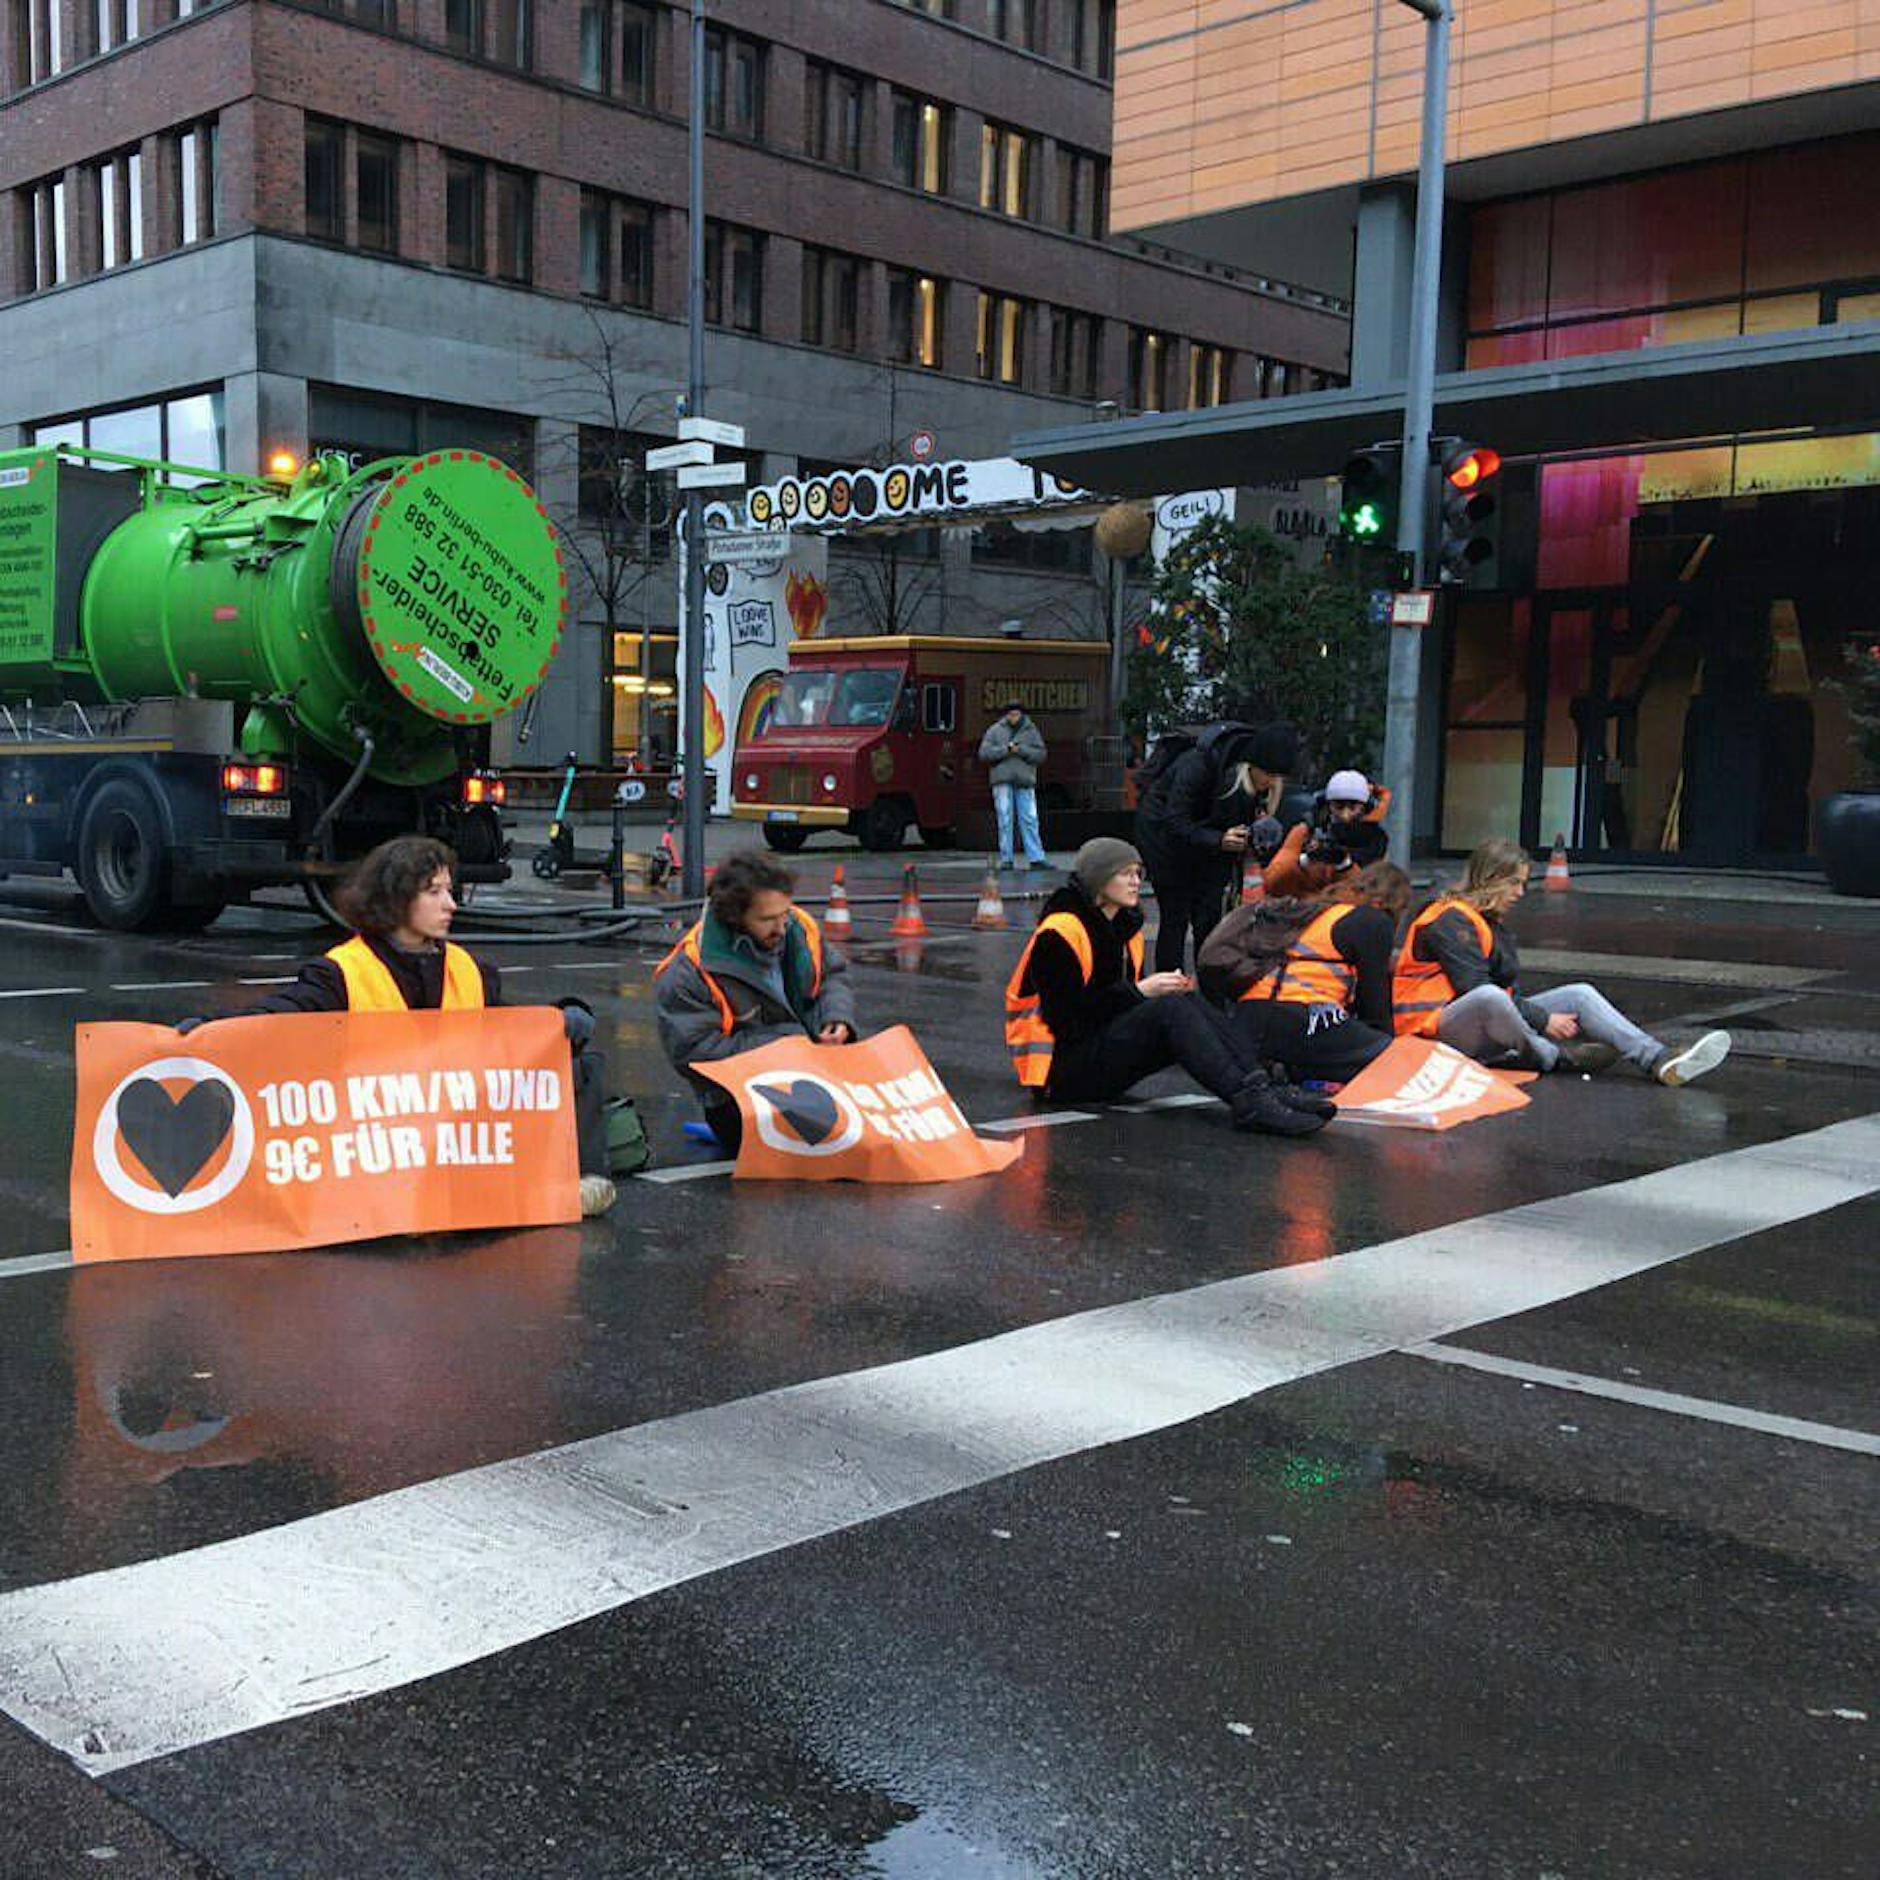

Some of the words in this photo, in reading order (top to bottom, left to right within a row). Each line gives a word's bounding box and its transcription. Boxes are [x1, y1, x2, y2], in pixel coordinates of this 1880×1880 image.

[404, 503, 437, 539] 588
[423, 486, 545, 603] www.kubu-berlin.de
[436, 532, 459, 560] 32
[407, 555, 501, 648] SERVICE
[461, 553, 512, 608] 030-51
[516, 606, 539, 636] Tel.
[257, 1079, 338, 1128] 100
[346, 1070, 477, 1121] KM/H
[484, 1069, 561, 1112] UND
[264, 1136, 322, 1185] 9€
[331, 1122, 427, 1178] FÜR
[435, 1121, 515, 1166] ALLE
